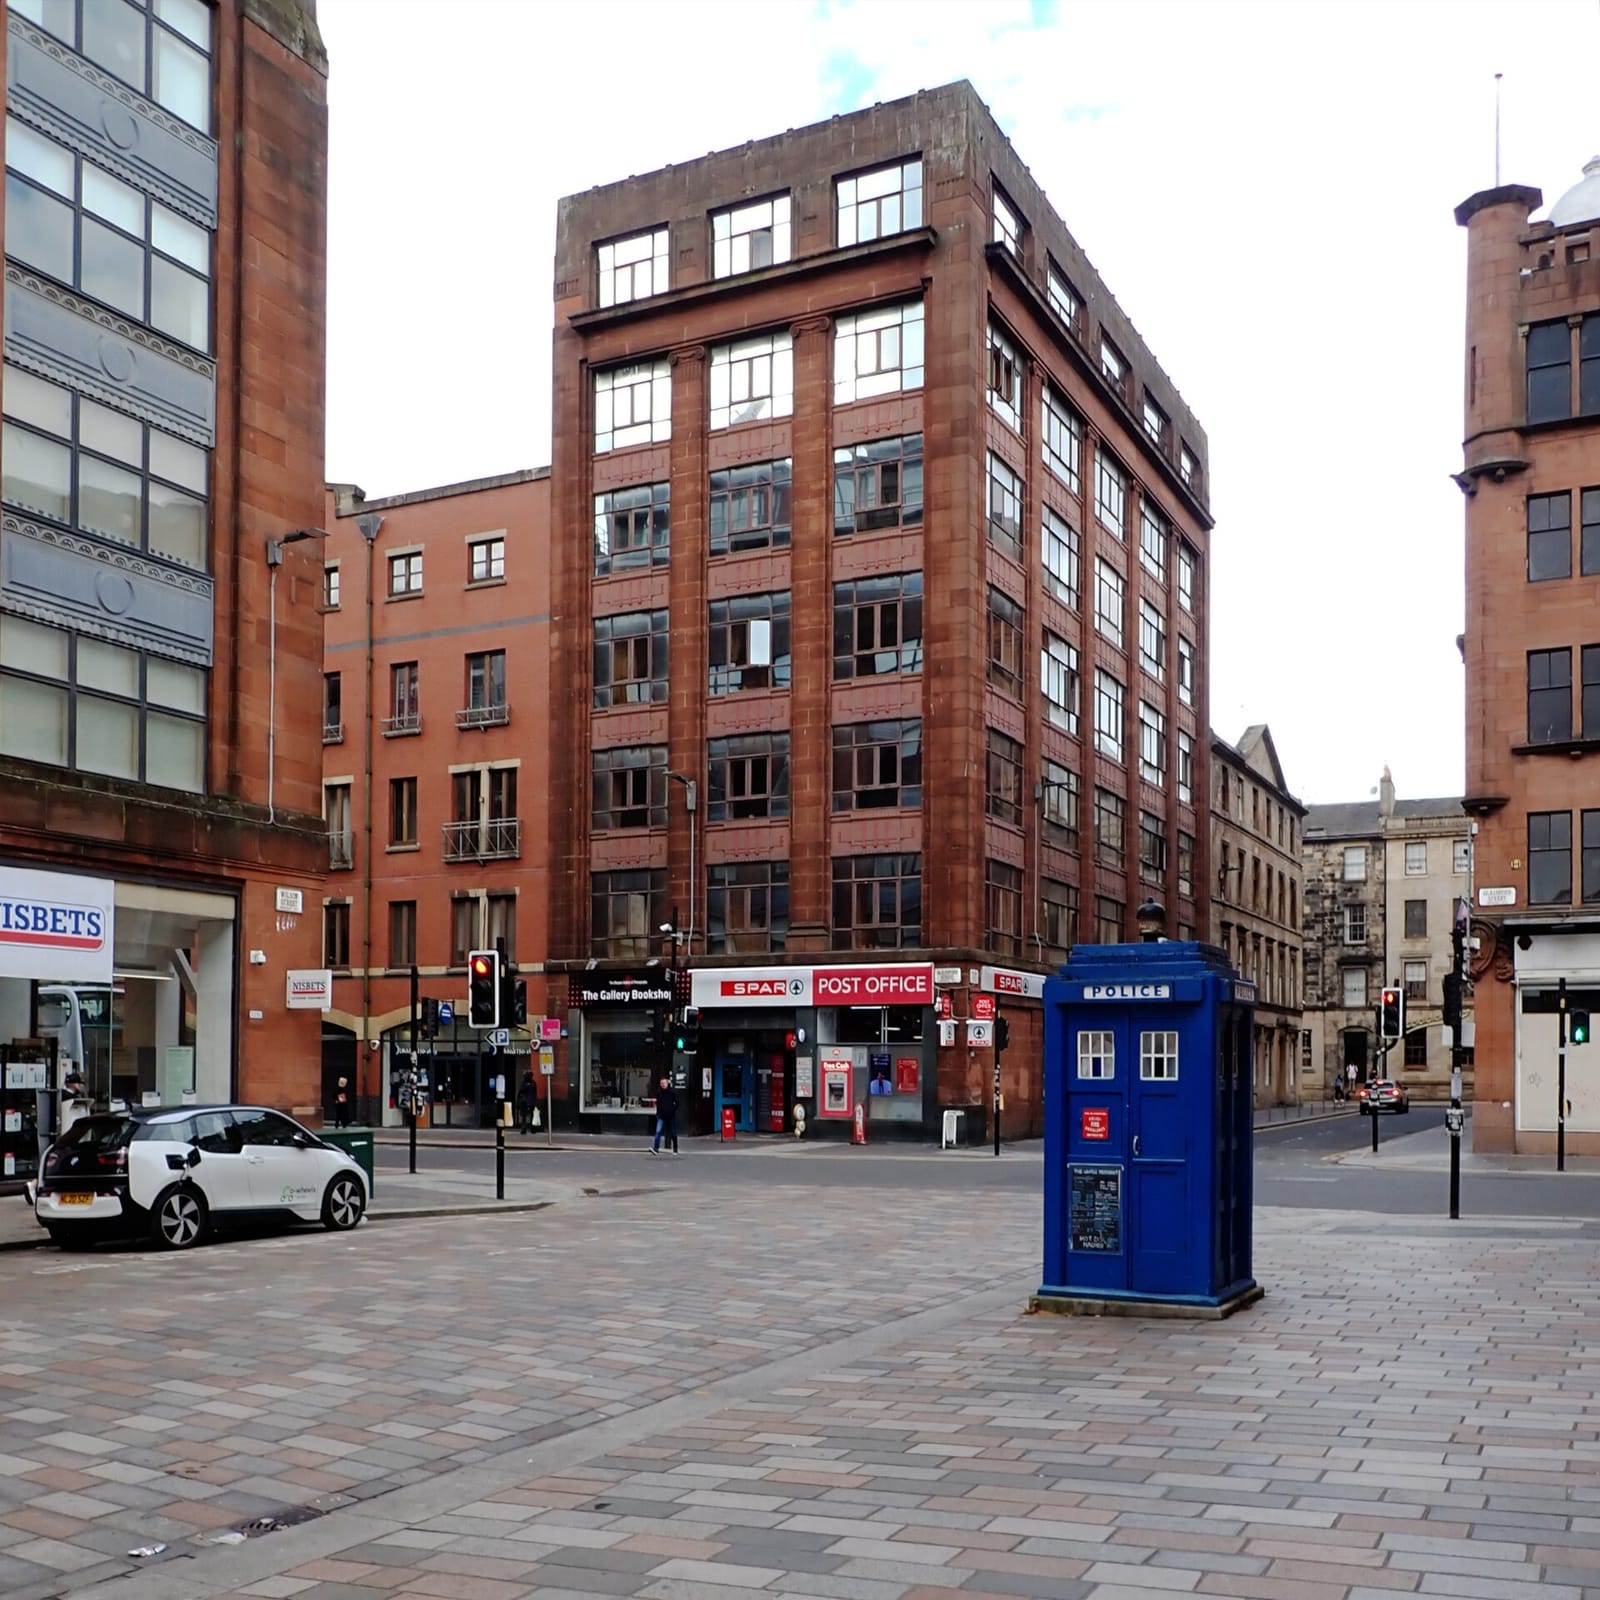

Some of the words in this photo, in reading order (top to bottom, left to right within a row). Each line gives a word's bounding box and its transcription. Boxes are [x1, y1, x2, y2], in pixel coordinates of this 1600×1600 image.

[0, 902, 101, 937] ISBETS
[293, 981, 326, 990] NISBETS
[733, 982, 786, 995] SPAR
[818, 977, 861, 994] POST
[865, 975, 927, 993] OFFICE
[1000, 976, 1022, 990] SPAR
[582, 990, 599, 1001] The
[600, 989, 630, 1002] Gallery
[1092, 986, 1163, 998] POLICE
